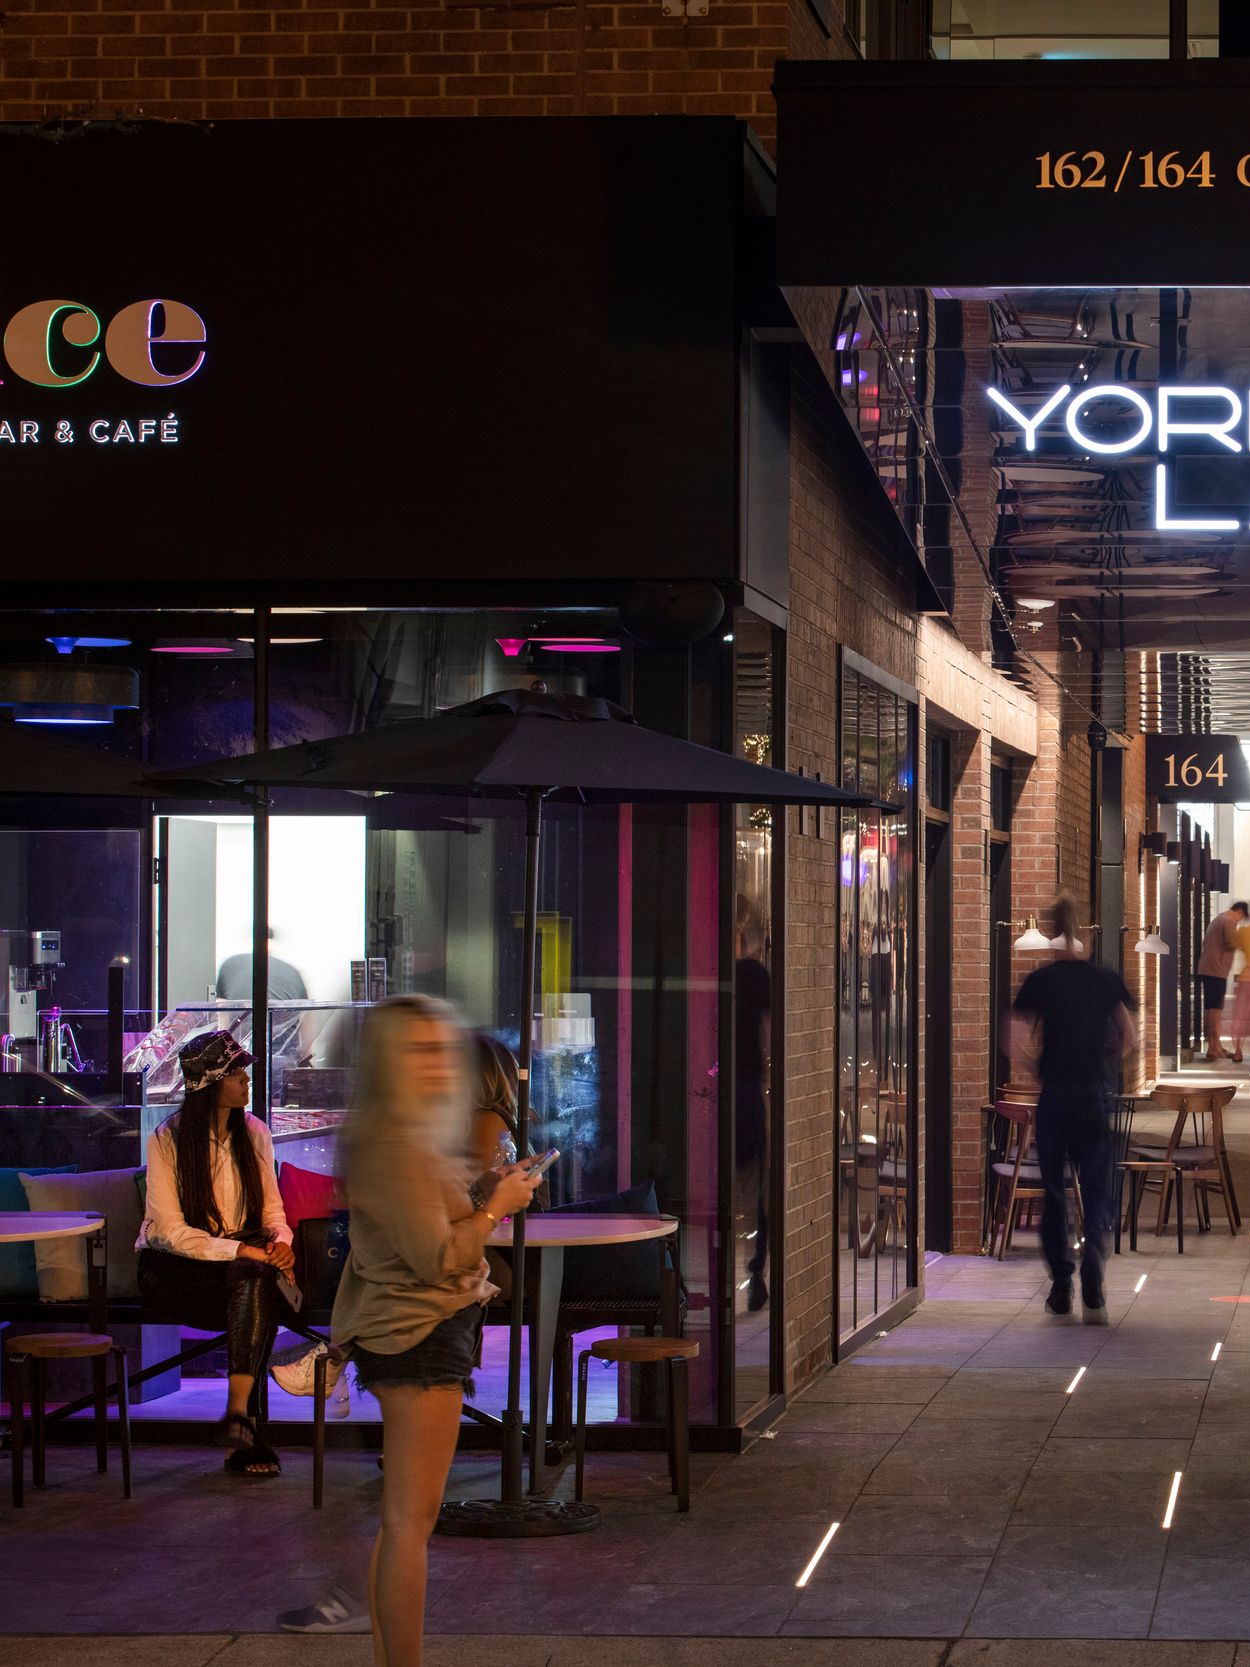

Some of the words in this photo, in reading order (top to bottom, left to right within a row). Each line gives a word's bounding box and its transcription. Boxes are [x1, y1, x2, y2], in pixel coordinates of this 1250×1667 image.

[0, 298, 207, 388] ce
[54, 420, 74, 444] &
[89, 411, 179, 445] CAFÉ
[1164, 752, 1229, 788] 164
